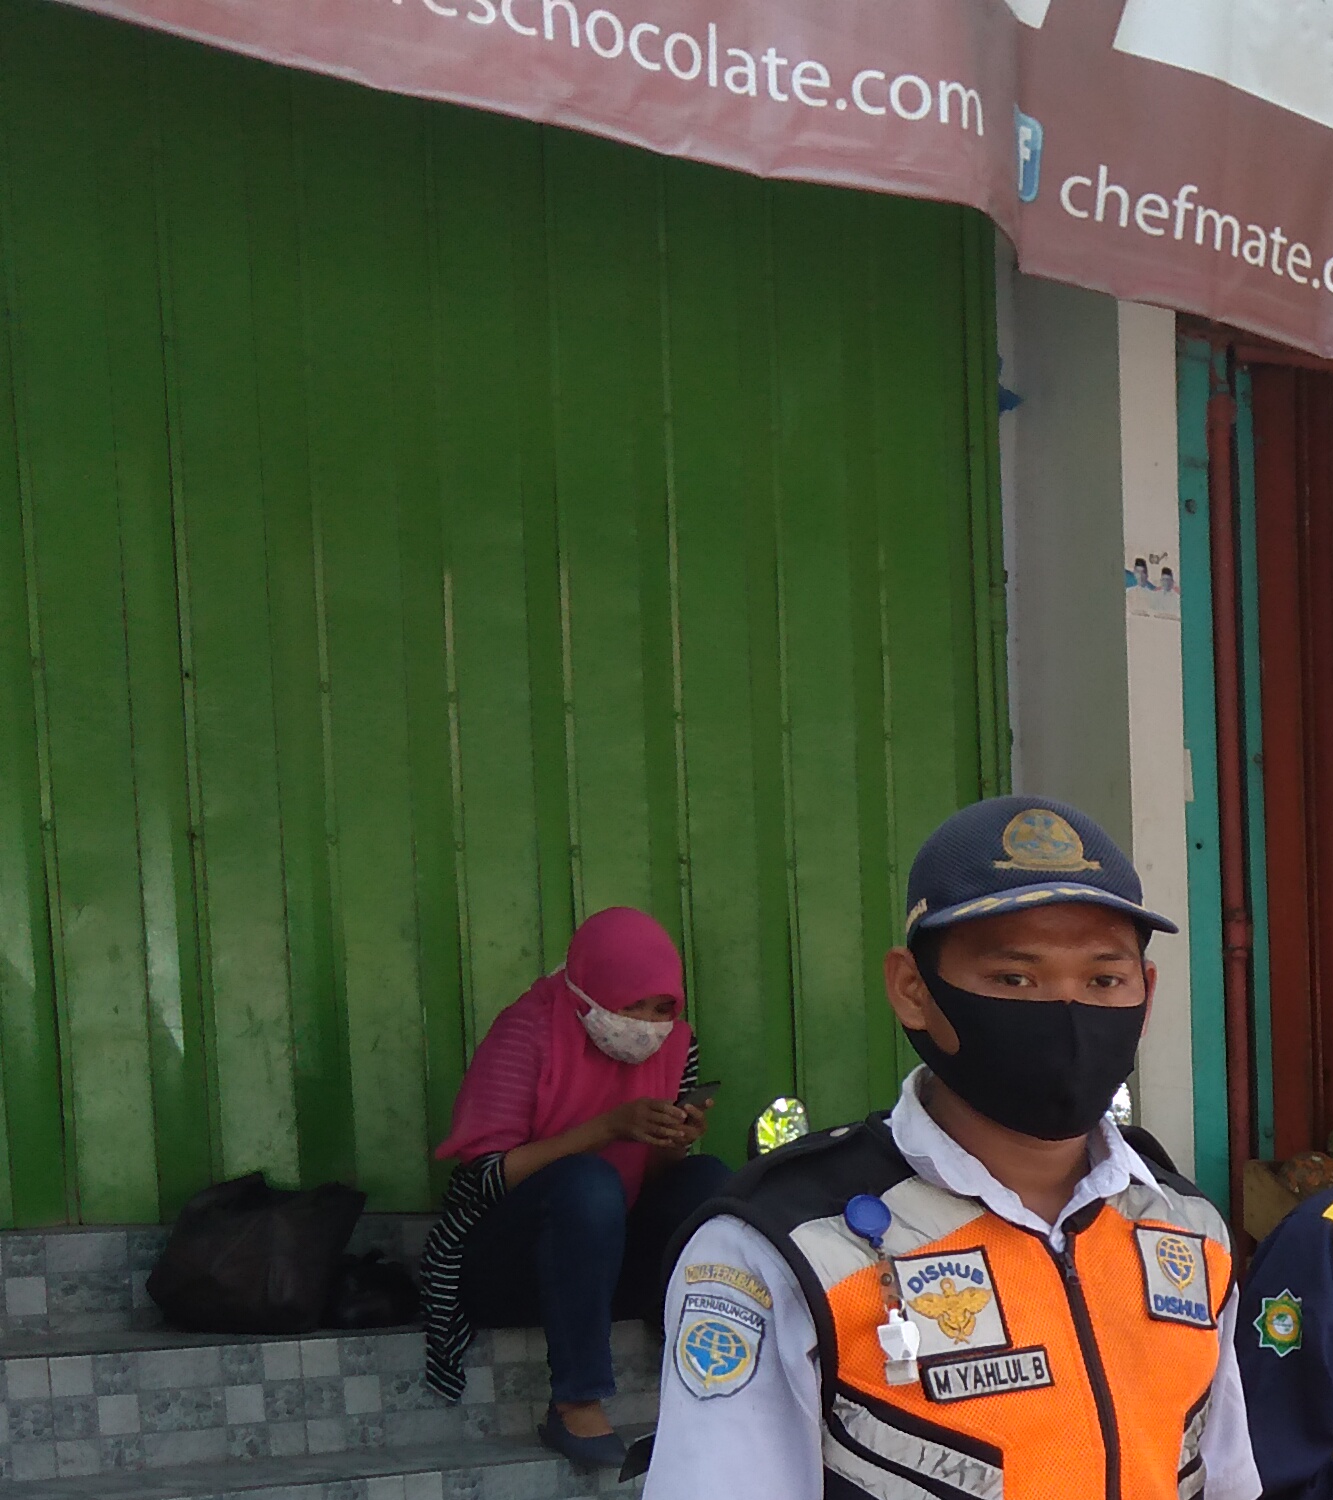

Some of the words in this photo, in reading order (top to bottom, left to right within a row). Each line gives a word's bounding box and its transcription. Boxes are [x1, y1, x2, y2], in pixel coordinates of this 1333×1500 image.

[393, 0, 985, 137] schocolate.com
[907, 1261, 985, 1294] DISHUB
[1153, 1293, 1208, 1321] DISHUB
[933, 1369, 953, 1396] M
[956, 1358, 1030, 1391] YAHLUL
[1032, 1356, 1045, 1380] B
